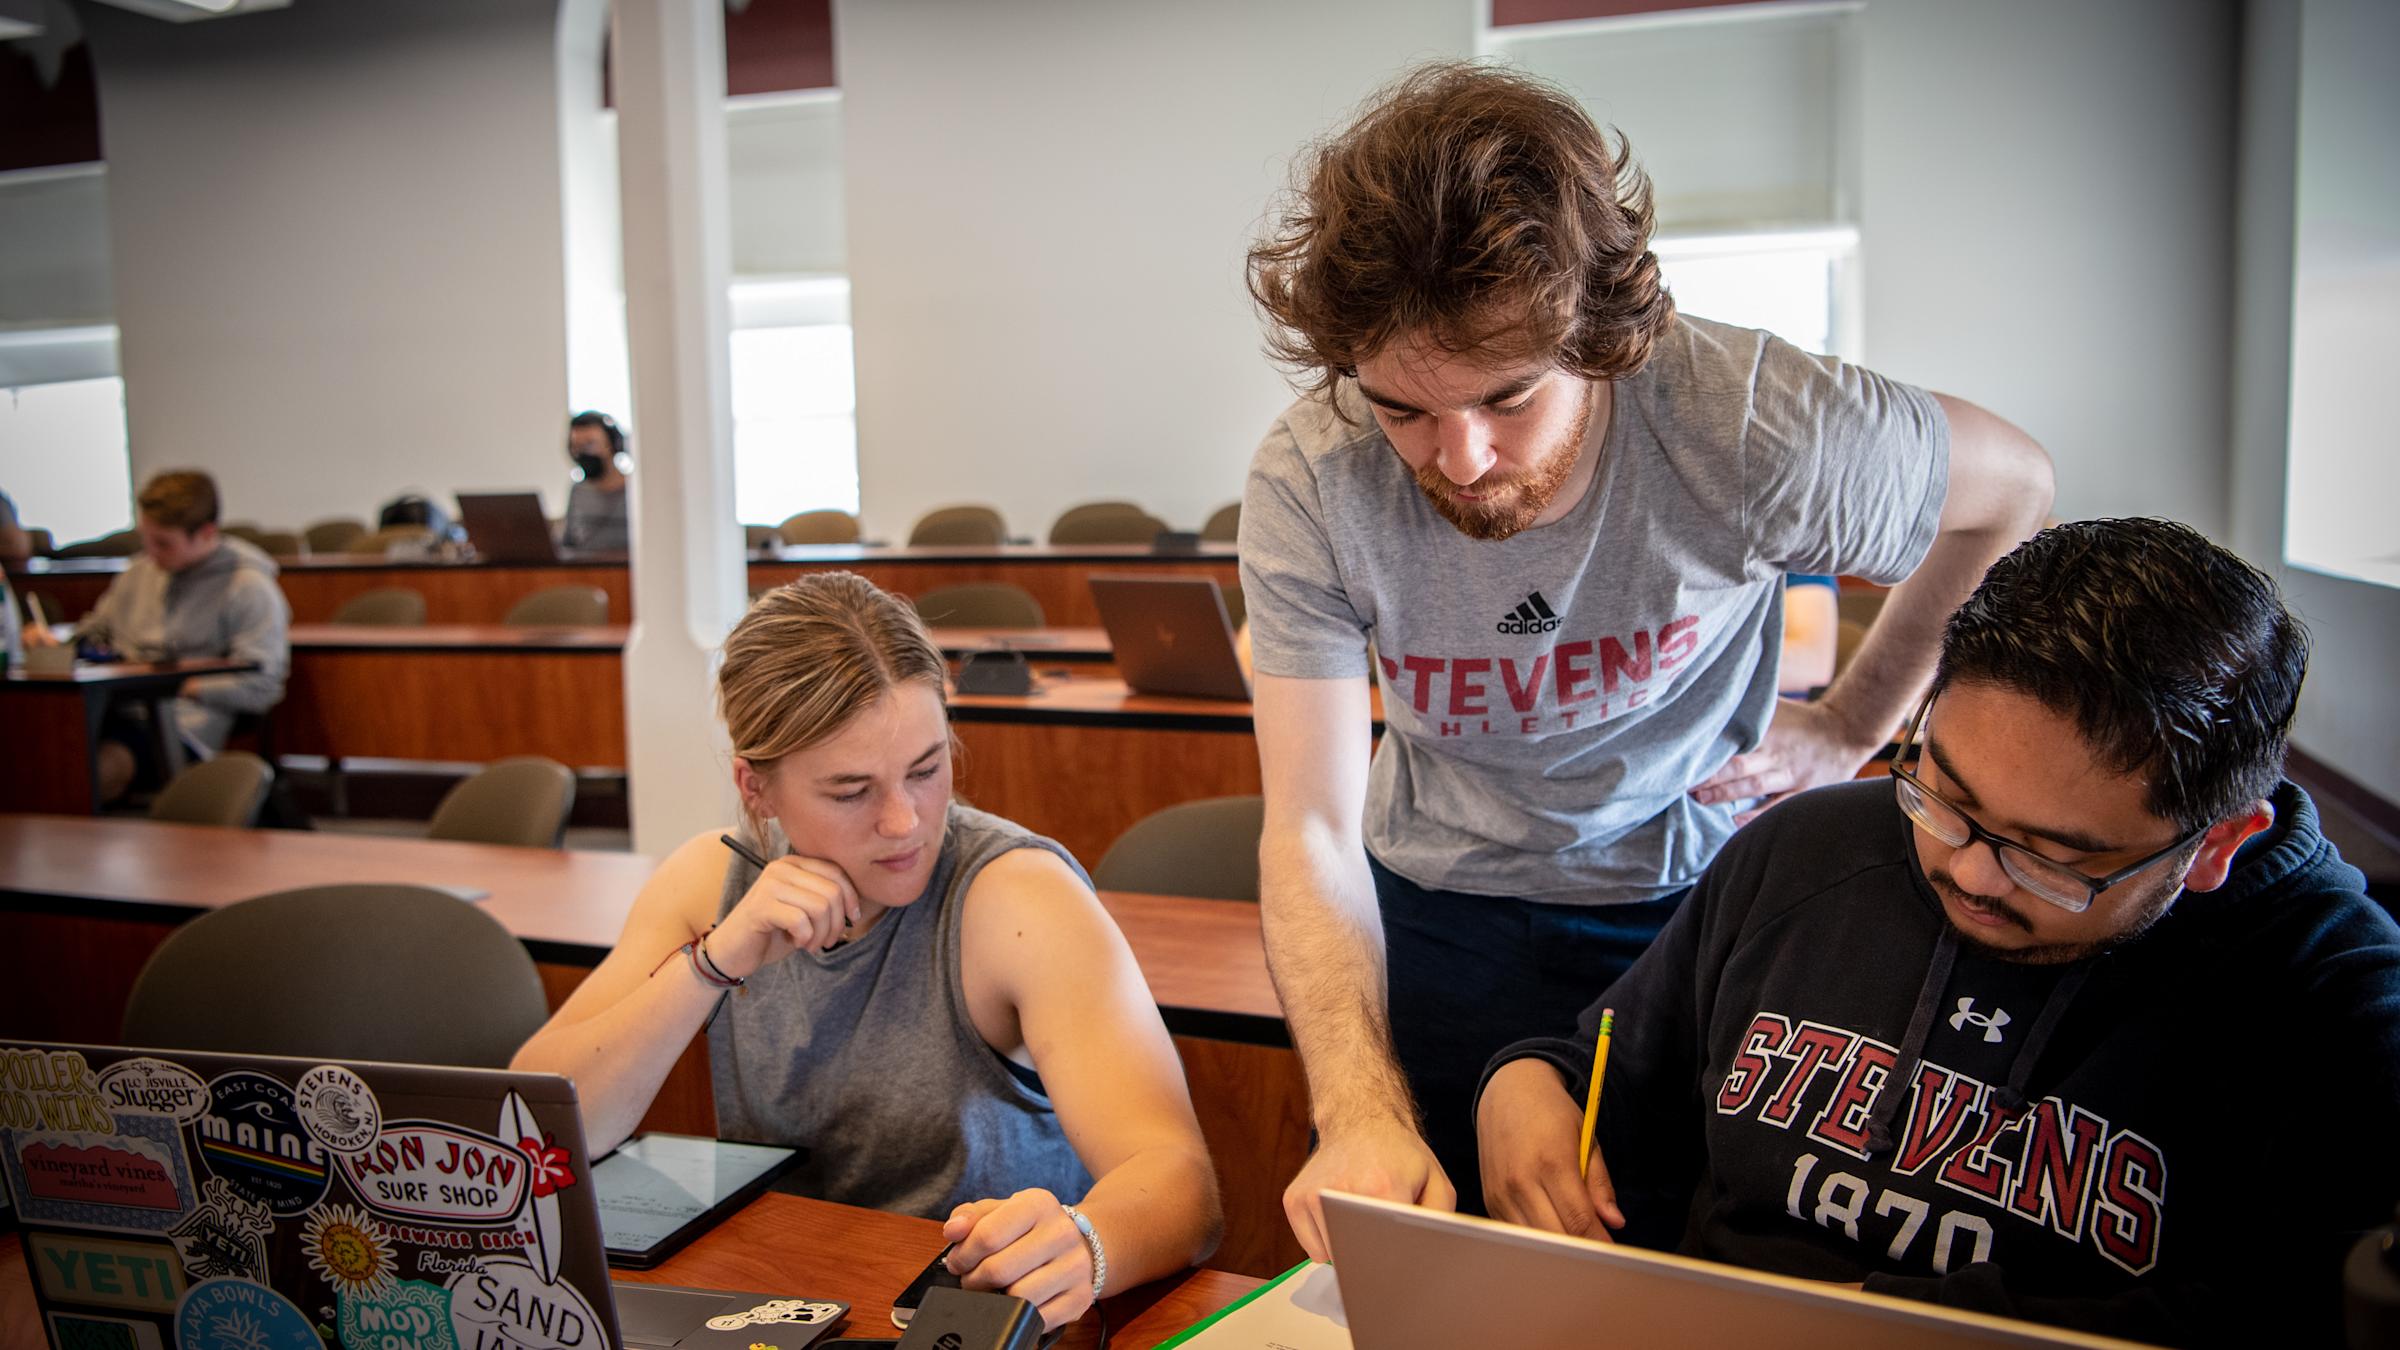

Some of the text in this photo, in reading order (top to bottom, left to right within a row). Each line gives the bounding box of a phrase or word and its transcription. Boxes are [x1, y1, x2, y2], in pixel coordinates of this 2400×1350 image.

[497, 617, 564, 634] adidas
[1379, 614, 1700, 716] TEVENS
[109, 1079, 196, 1113] Slugger
[215, 1081, 297, 1112] EAST COA
[301, 1071, 362, 1109] STEVENS
[0, 1090, 113, 1135] OD WINS
[202, 1113, 325, 1166] MAINE
[1717, 1011, 2167, 1278] STEVENS
[29, 1154, 166, 1182] vineyard vines
[352, 1136, 516, 1188] RON JON
[104, 1181, 146, 1194] vineyard
[276, 1196, 302, 1208] MIND
[377, 1181, 498, 1208] SURF SHOP
[1785, 1152, 1995, 1275] 1870
[205, 1227, 247, 1262] YETI
[378, 1222, 537, 1248] EARWATER BEACH
[44, 1247, 176, 1301] YETI
[420, 1252, 488, 1275] Florida
[187, 1285, 281, 1350] PLAYA BOWLS
[360, 1305, 432, 1337] MOD
[474, 1275, 584, 1346] SAND
